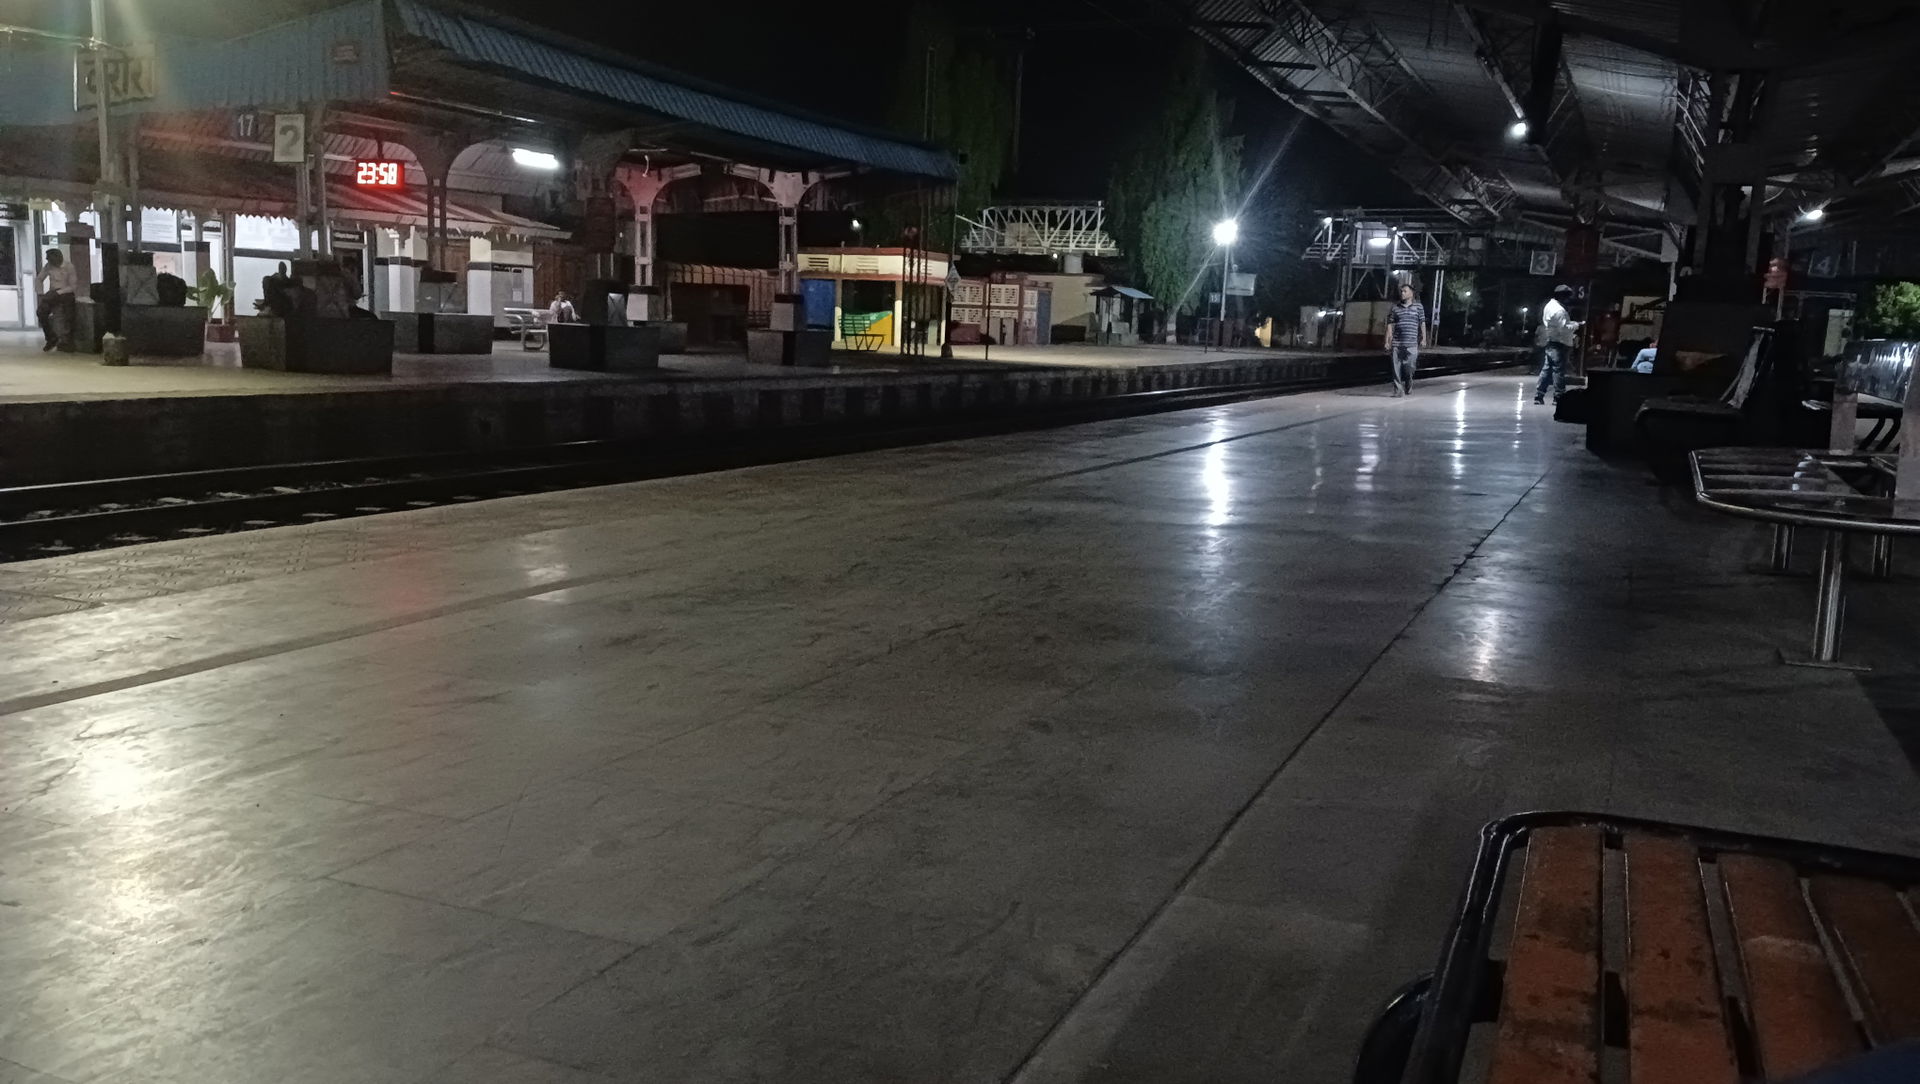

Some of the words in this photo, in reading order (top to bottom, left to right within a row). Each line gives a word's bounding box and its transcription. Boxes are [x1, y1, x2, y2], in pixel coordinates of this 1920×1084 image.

[238, 113, 254, 137] 17
[279, 124, 300, 156] 2
[356, 162, 398, 185] 23:58
[1536, 254, 1549, 272] 3
[1816, 255, 1831, 274] 4
